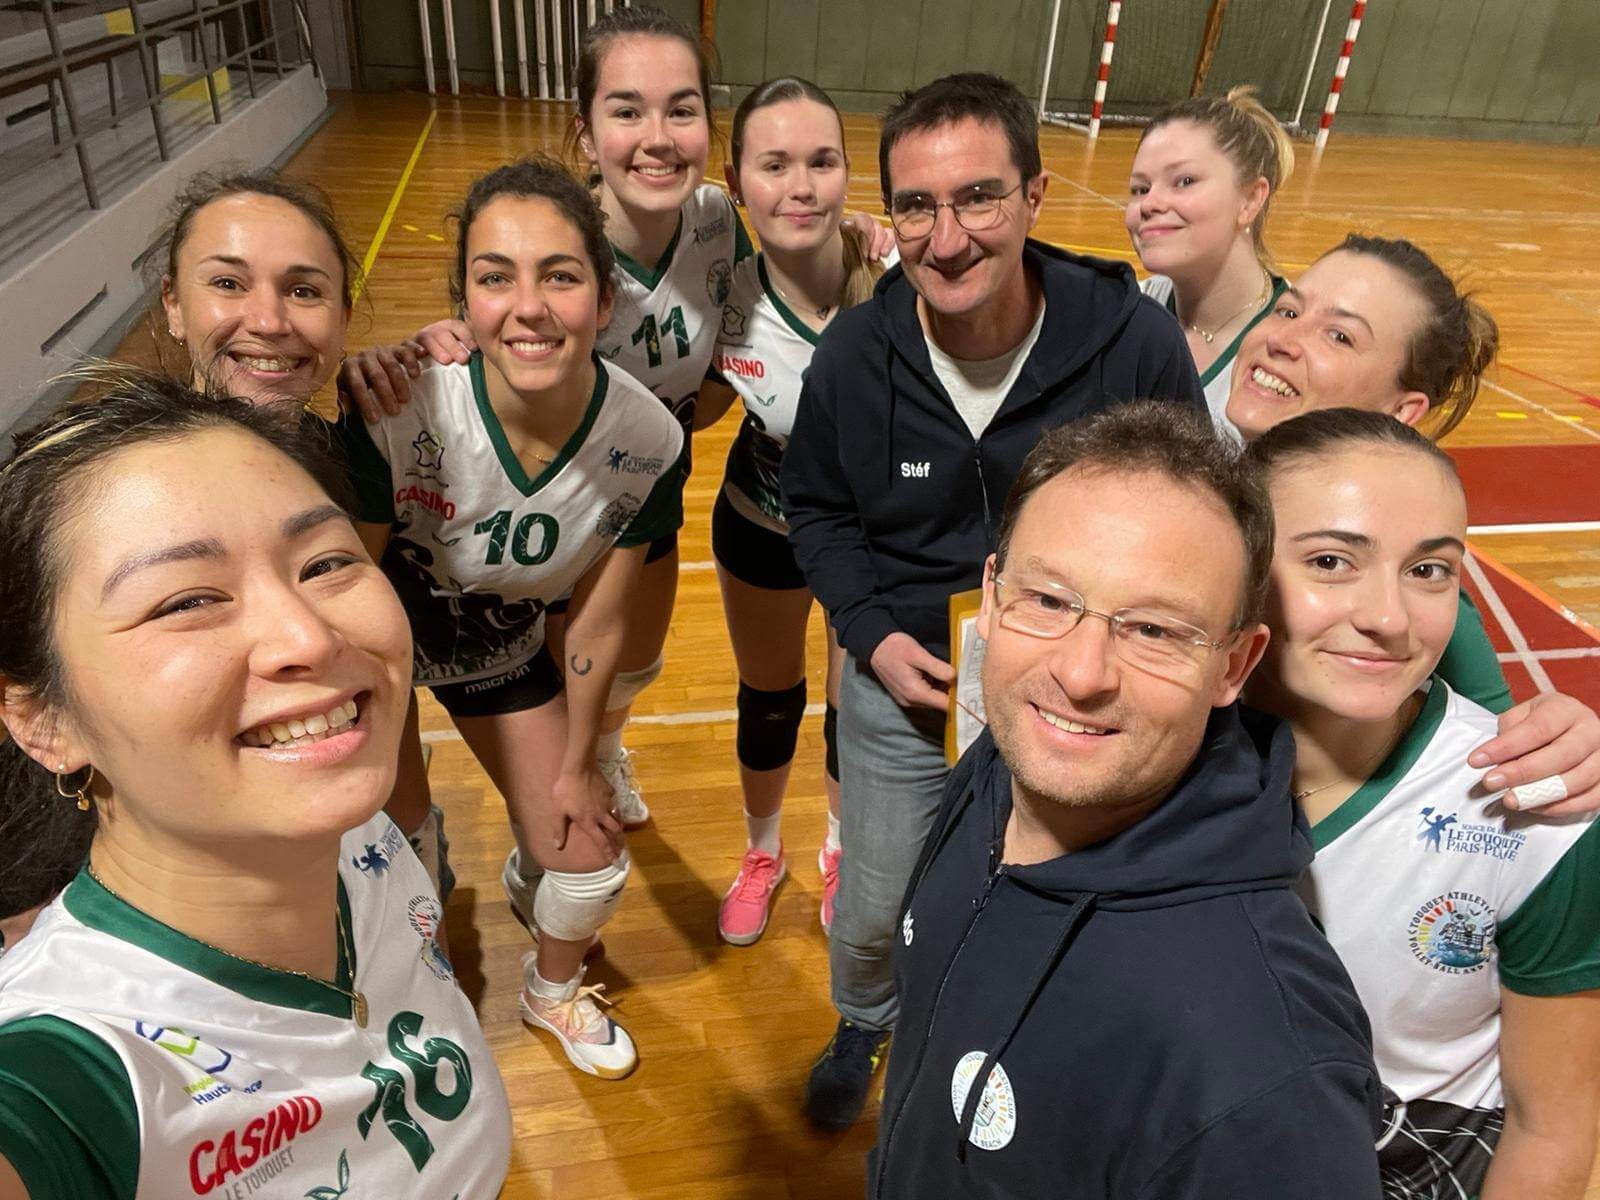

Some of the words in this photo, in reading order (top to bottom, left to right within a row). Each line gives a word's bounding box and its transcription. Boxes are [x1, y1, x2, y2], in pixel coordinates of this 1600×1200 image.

[631, 304, 691, 368] 11
[900, 461, 931, 478] Stéf
[395, 485, 456, 521] CASINO
[473, 509, 560, 566] 10
[464, 663, 531, 695] macron
[357, 1010, 473, 1174] 16
[188, 1094, 323, 1196] CASINO
[241, 1145, 296, 1195] TOUQUET
